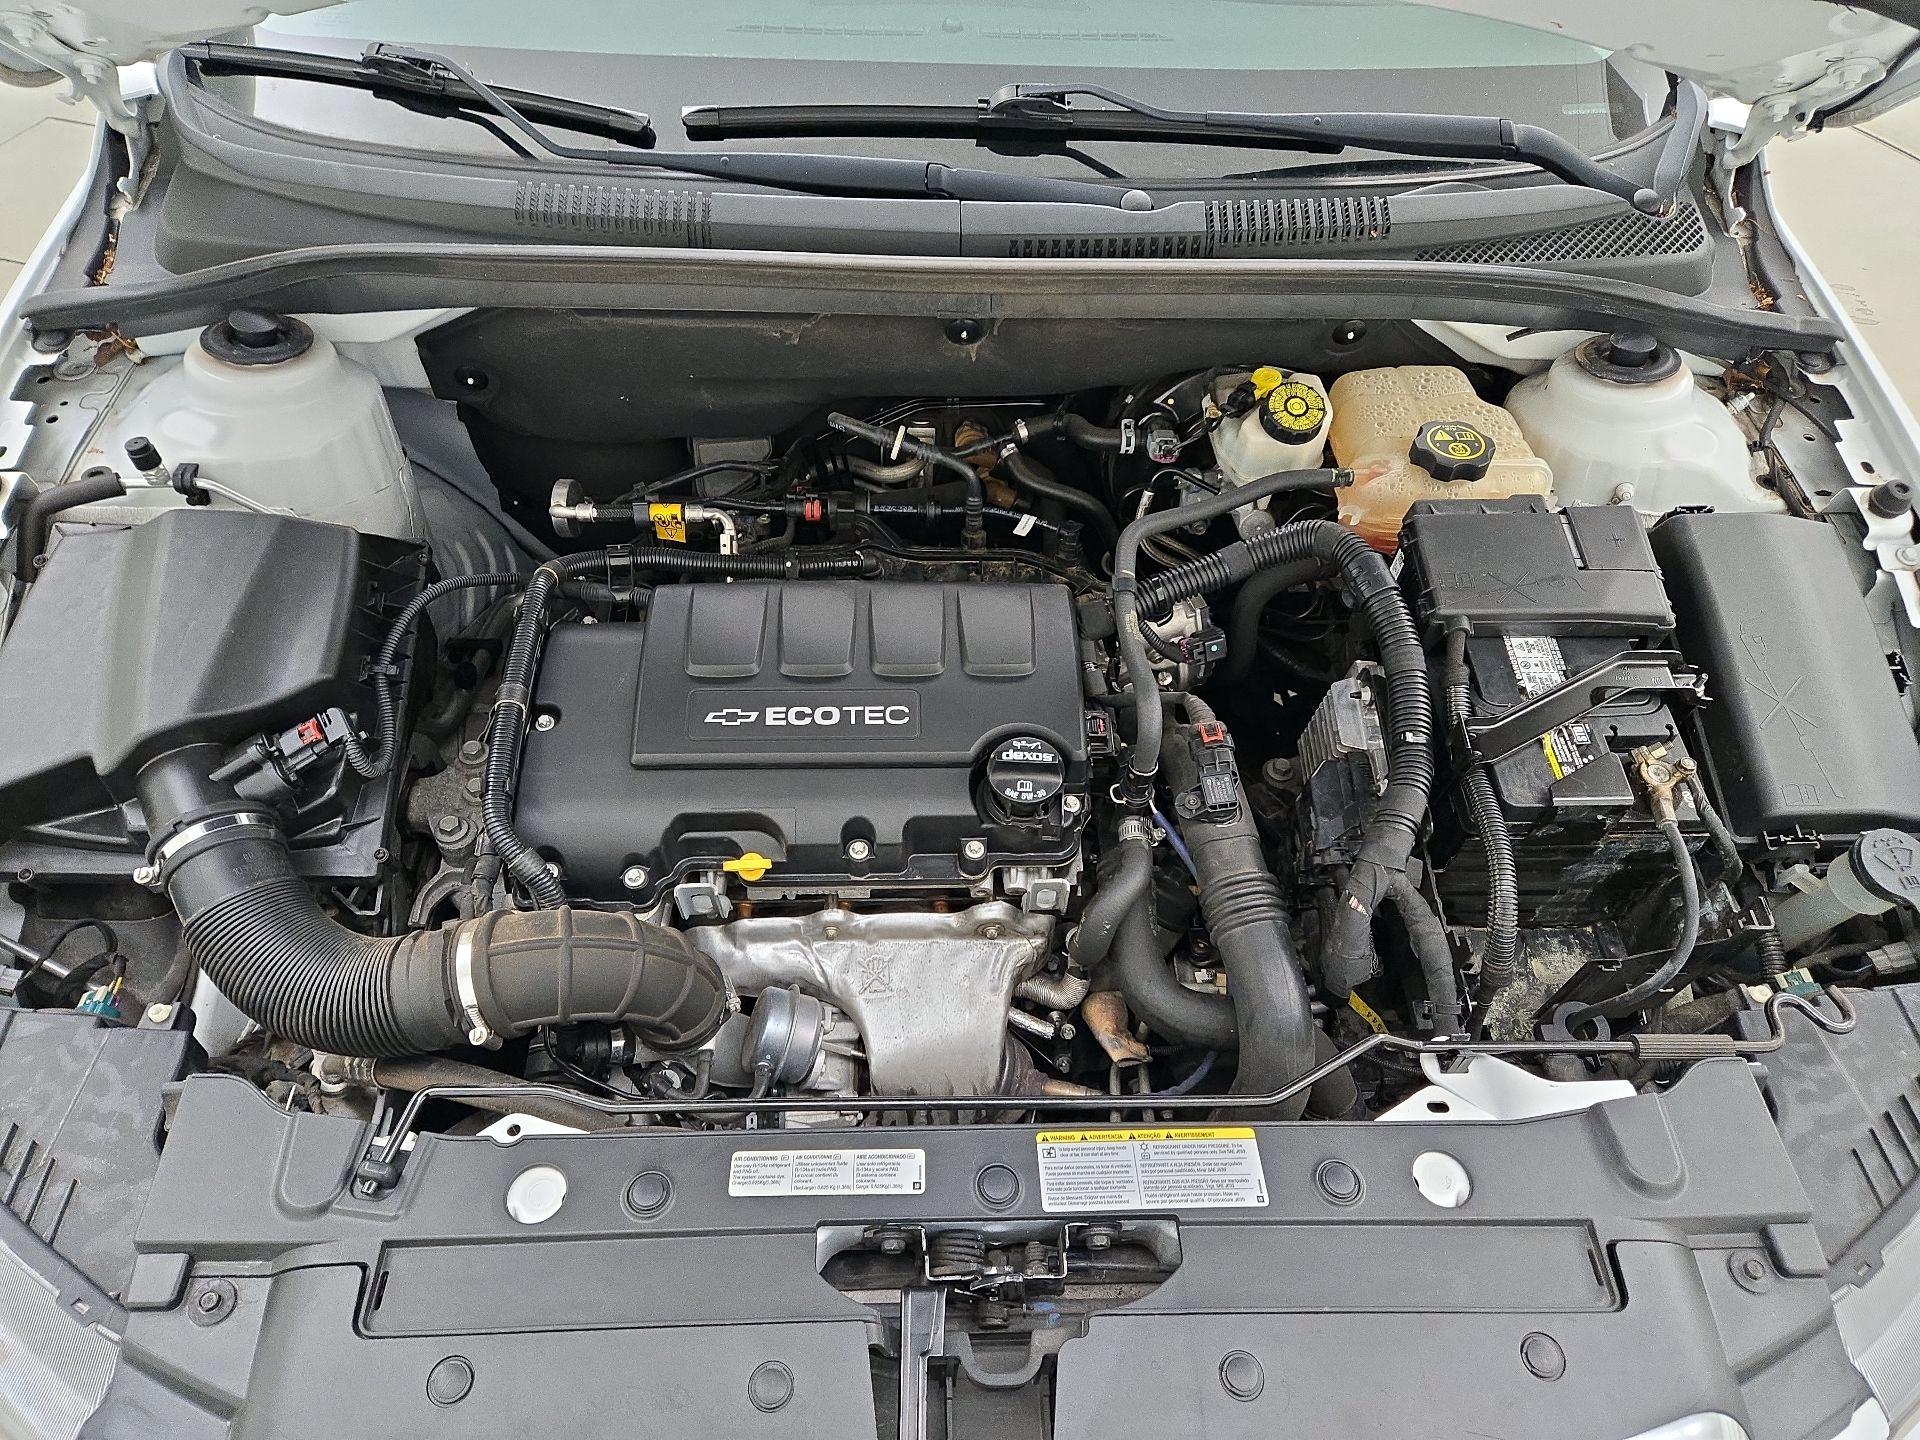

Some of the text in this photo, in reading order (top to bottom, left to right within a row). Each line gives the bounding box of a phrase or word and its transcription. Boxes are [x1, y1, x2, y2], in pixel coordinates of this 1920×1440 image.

[765, 705, 910, 726] ECOTEC
[1002, 749, 1055, 762] dexos
[1004, 788, 1046, 800] SAE 5W-30
